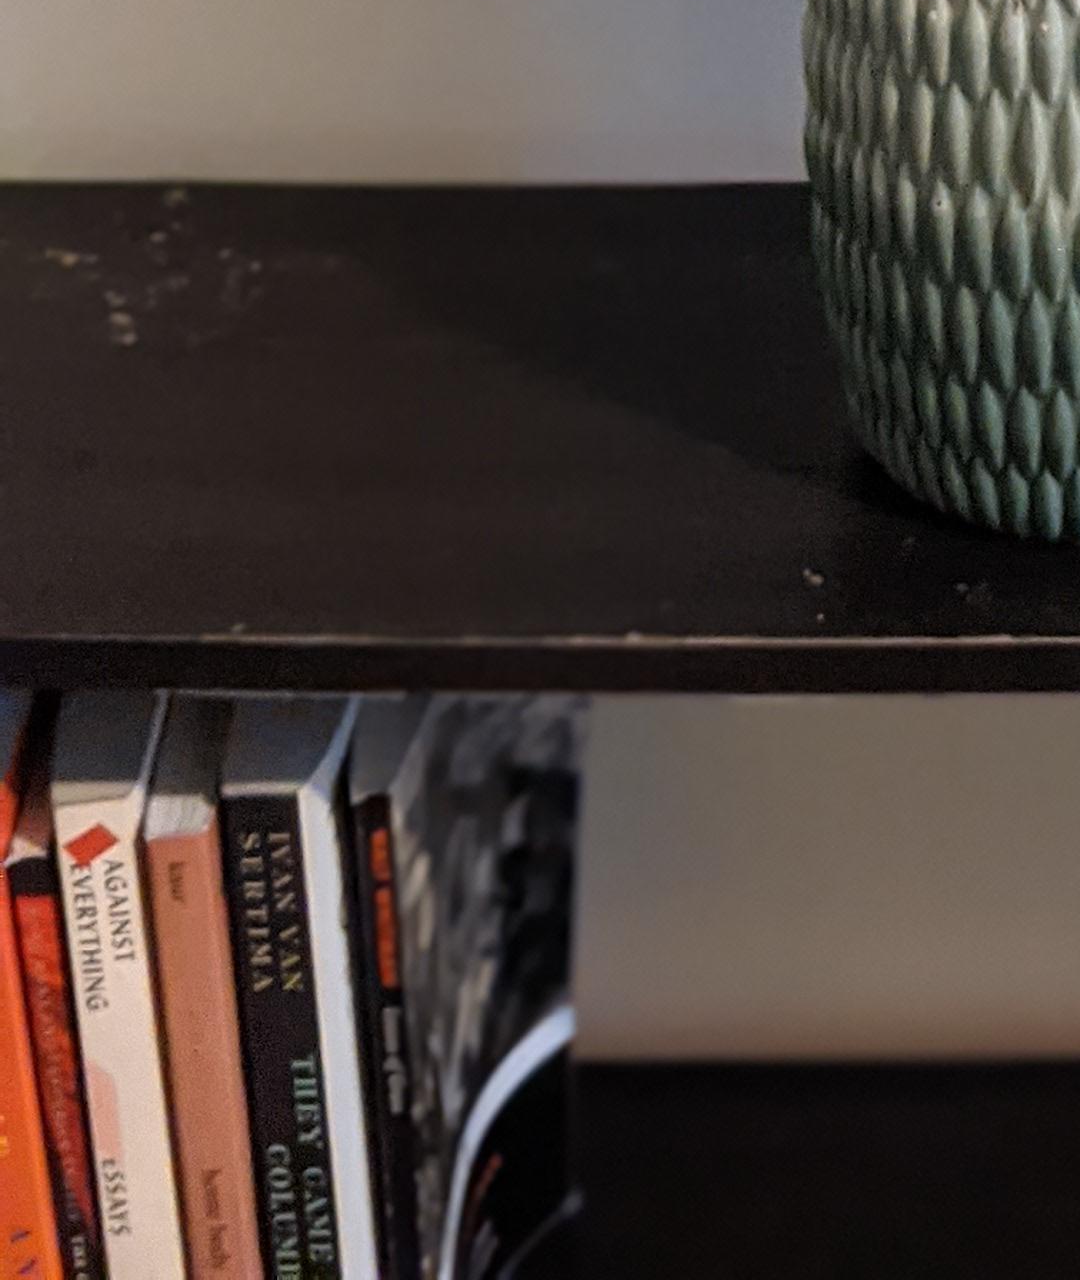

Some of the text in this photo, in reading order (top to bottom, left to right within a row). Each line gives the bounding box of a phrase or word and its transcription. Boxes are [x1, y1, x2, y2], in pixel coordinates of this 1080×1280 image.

[70, 863, 109, 1012] EVERYTHING
[102, 858, 136, 962] AGAINST
[239, 831, 275, 992] SERTIMA
[291, 1052, 334, 1263] THEY CAME
